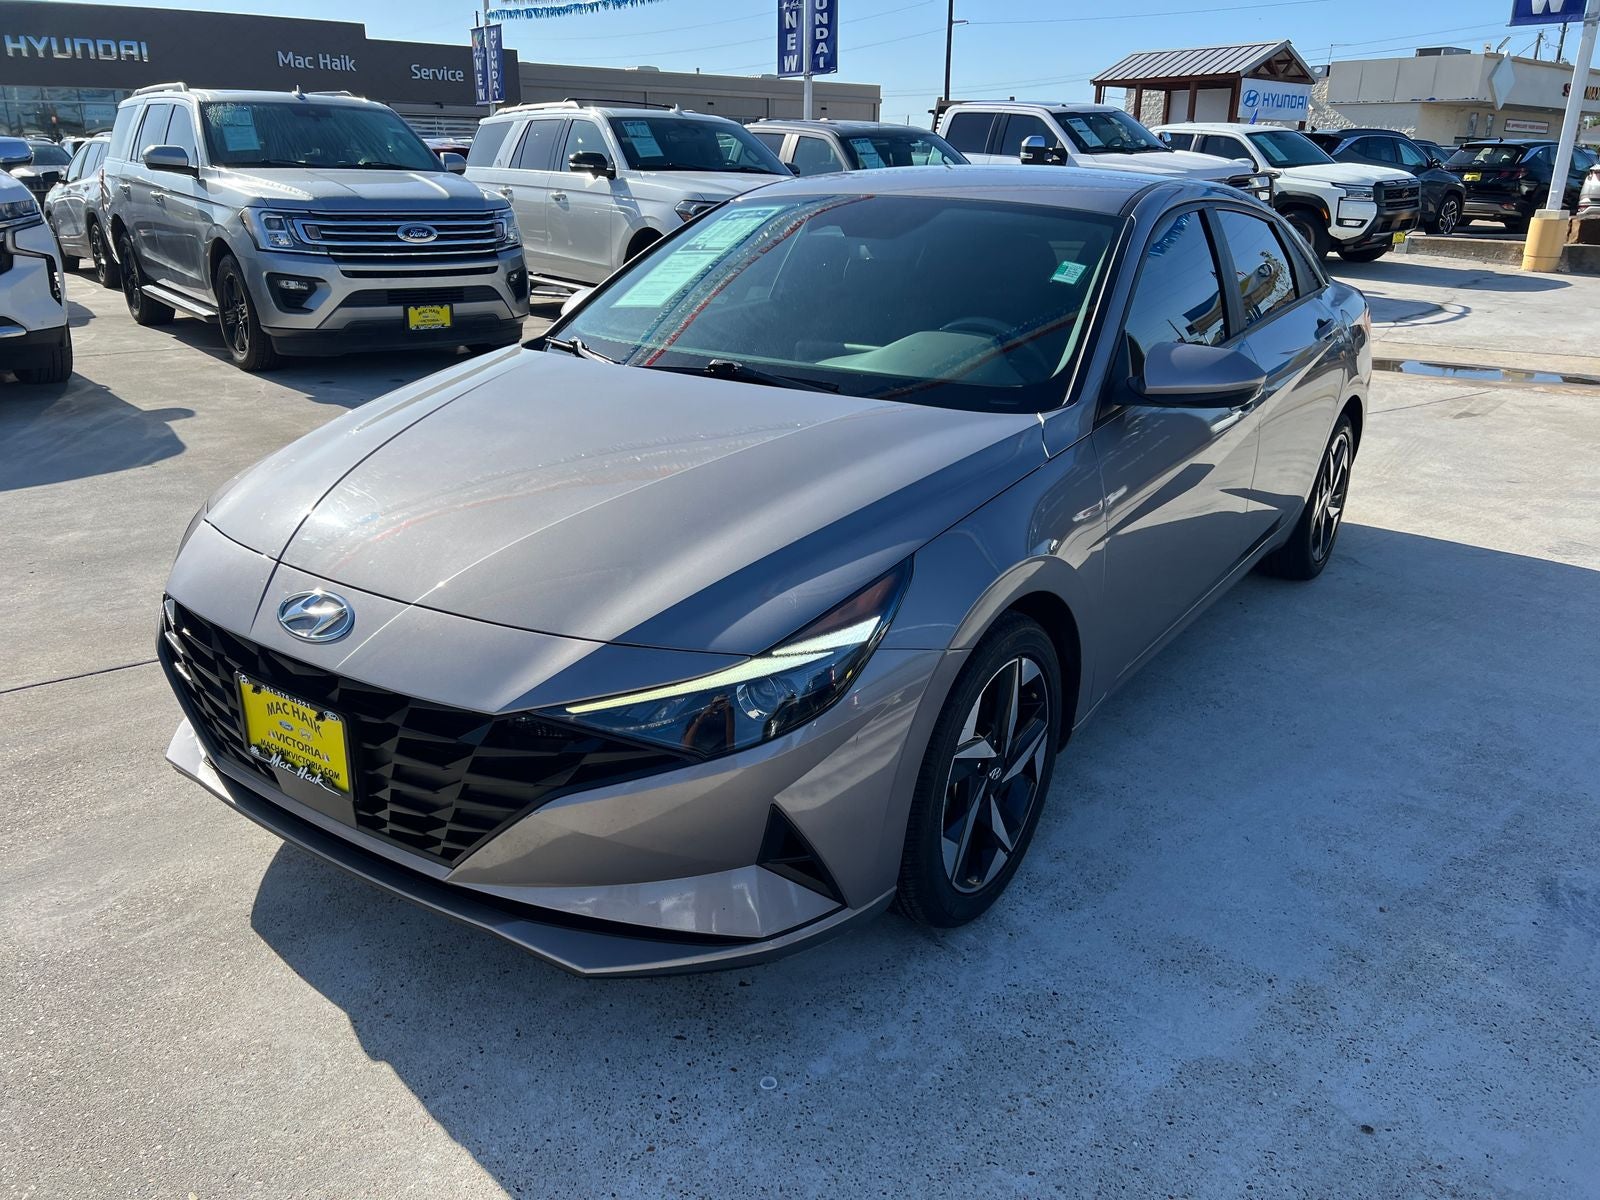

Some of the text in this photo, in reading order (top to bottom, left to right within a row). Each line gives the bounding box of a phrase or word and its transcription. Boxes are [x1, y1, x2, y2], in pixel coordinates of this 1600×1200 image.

[4, 34, 149, 63] HYUNDAI
[783, 11, 798, 72] NEW
[277, 50, 356, 72] Mac Haik
[410, 63, 464, 82] Service
[490, 30, 499, 99] HYUNDAI
[475, 58, 485, 100] NEW
[1261, 92, 1308, 110] HYUNDAI
[408, 230, 428, 238] Ford
[266, 702, 290, 717] MAC
[291, 704, 323, 738] HAIK
[275, 730, 322, 760] VICTORIA
[270, 752, 294, 774] Mac
